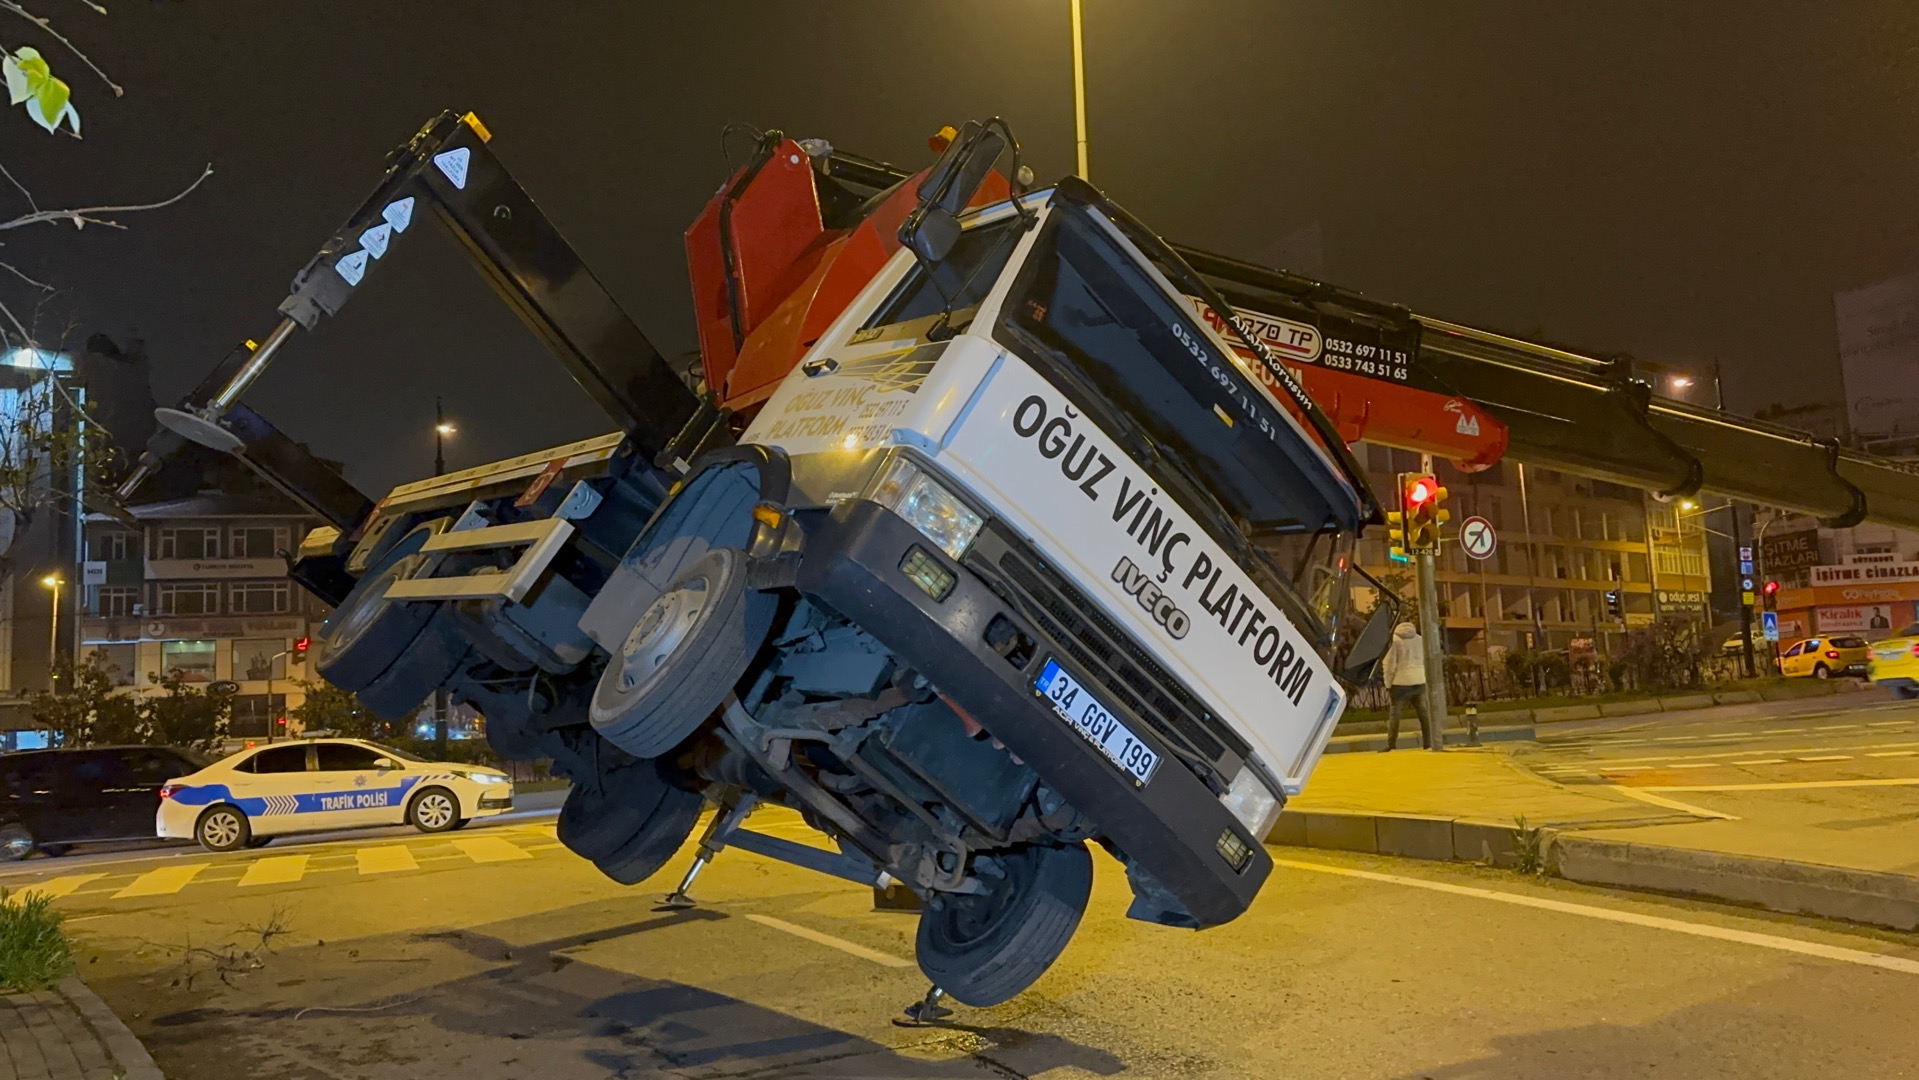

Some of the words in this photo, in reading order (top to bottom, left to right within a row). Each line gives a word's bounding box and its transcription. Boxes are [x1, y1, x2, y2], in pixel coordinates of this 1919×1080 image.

[1288, 328, 1313, 346] TP
[1229, 315, 1263, 352] Allah
[1265, 351, 1313, 411] Korusun
[1325, 337, 1353, 354] 0532
[1355, 344, 1376, 358] 697
[1380, 348, 1391, 361] 11
[1394, 351, 1407, 365] 51
[1324, 353, 1352, 370] 0533
[1355, 359, 1375, 374] 743
[1377, 363, 1390, 377] 51
[1393, 367, 1407, 380] 65
[1172, 323, 1208, 367] 0532
[1211, 366, 1238, 395] 697
[1242, 395, 1256, 419] 11
[1259, 417, 1276, 441] 51
[784, 387, 835, 414] OĞUZ
[829, 383, 877, 412] VİNÇ
[766, 414, 850, 440] PLATFORM
[1012, 395, 1117, 502] OĞUZ
[1112, 476, 1191, 583] VİNÇ
[1182, 551, 1314, 707] PLATFORM
[1816, 567, 1861, 582] İŞİTME
[1111, 555, 1191, 640] IVECO
[1040, 678, 1050, 688] TR
[1051, 676, 1079, 711] 34
[1081, 703, 1118, 745] GGV
[1119, 737, 1152, 777] 199
[1052, 705, 1074, 726] ACR
[320, 793, 354, 811] TRAFİK
[356, 791, 388, 808] POLİSİ
